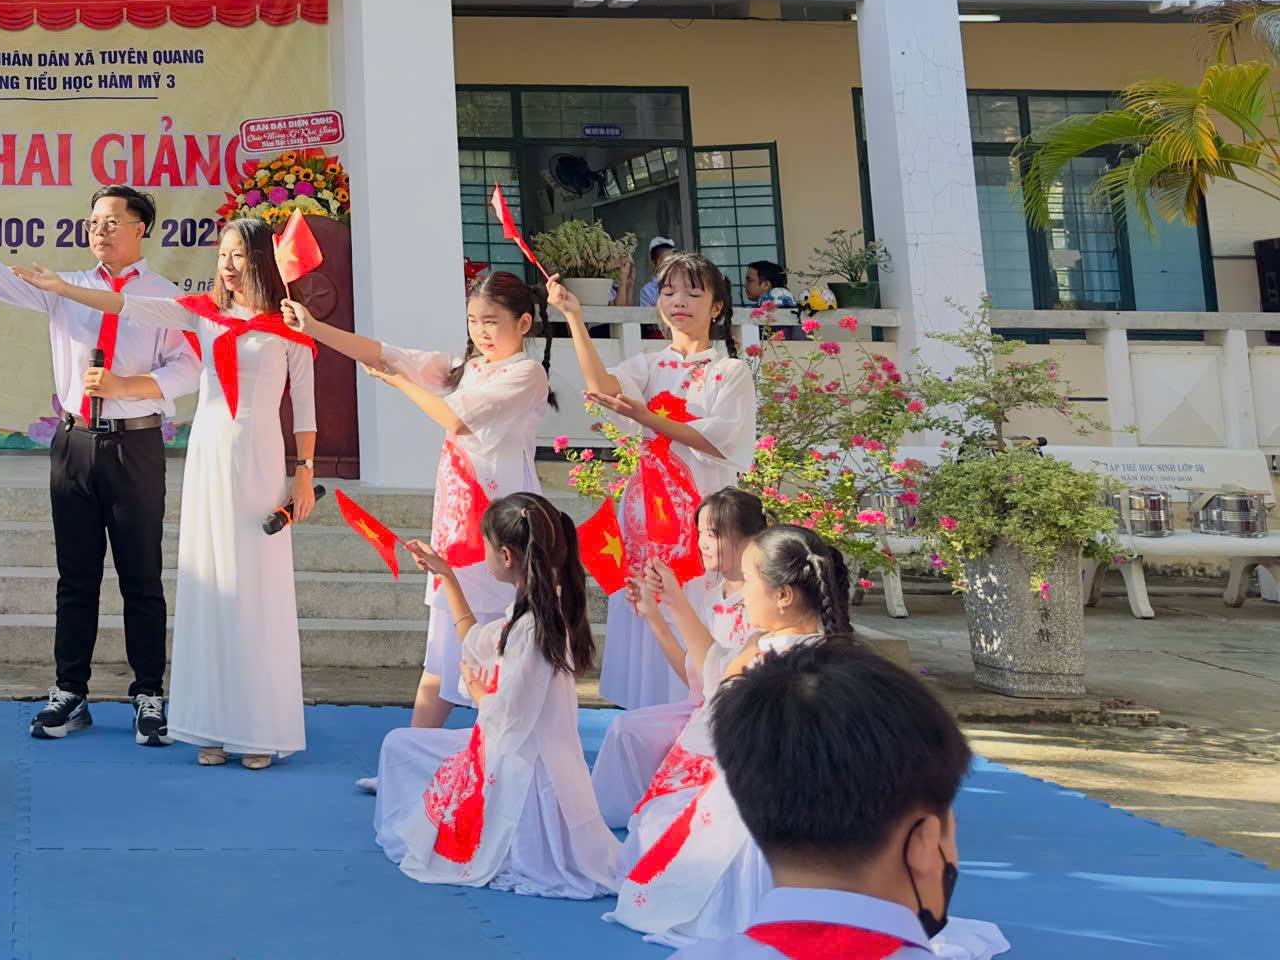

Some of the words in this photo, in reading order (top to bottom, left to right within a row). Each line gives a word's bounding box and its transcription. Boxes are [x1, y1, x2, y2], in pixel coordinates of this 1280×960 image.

[37, 49, 70, 67] DÂN
[74, 49, 95, 66] XÃ
[99, 48, 148, 65] TUYÊN
[152, 49, 204, 65] QUANG
[24, 71, 58, 91] TIỂU
[62, 74, 93, 93] HỌC
[98, 72, 134, 89] HÀM
[138, 72, 162, 89] MỸ
[166, 75, 176, 88] 3
[249, 123, 270, 132] BAN
[310, 116, 334, 126] CMHS
[161, 218, 220, 248] 202
[183, 278, 192, 291] 9
[197, 278, 215, 291] nă
